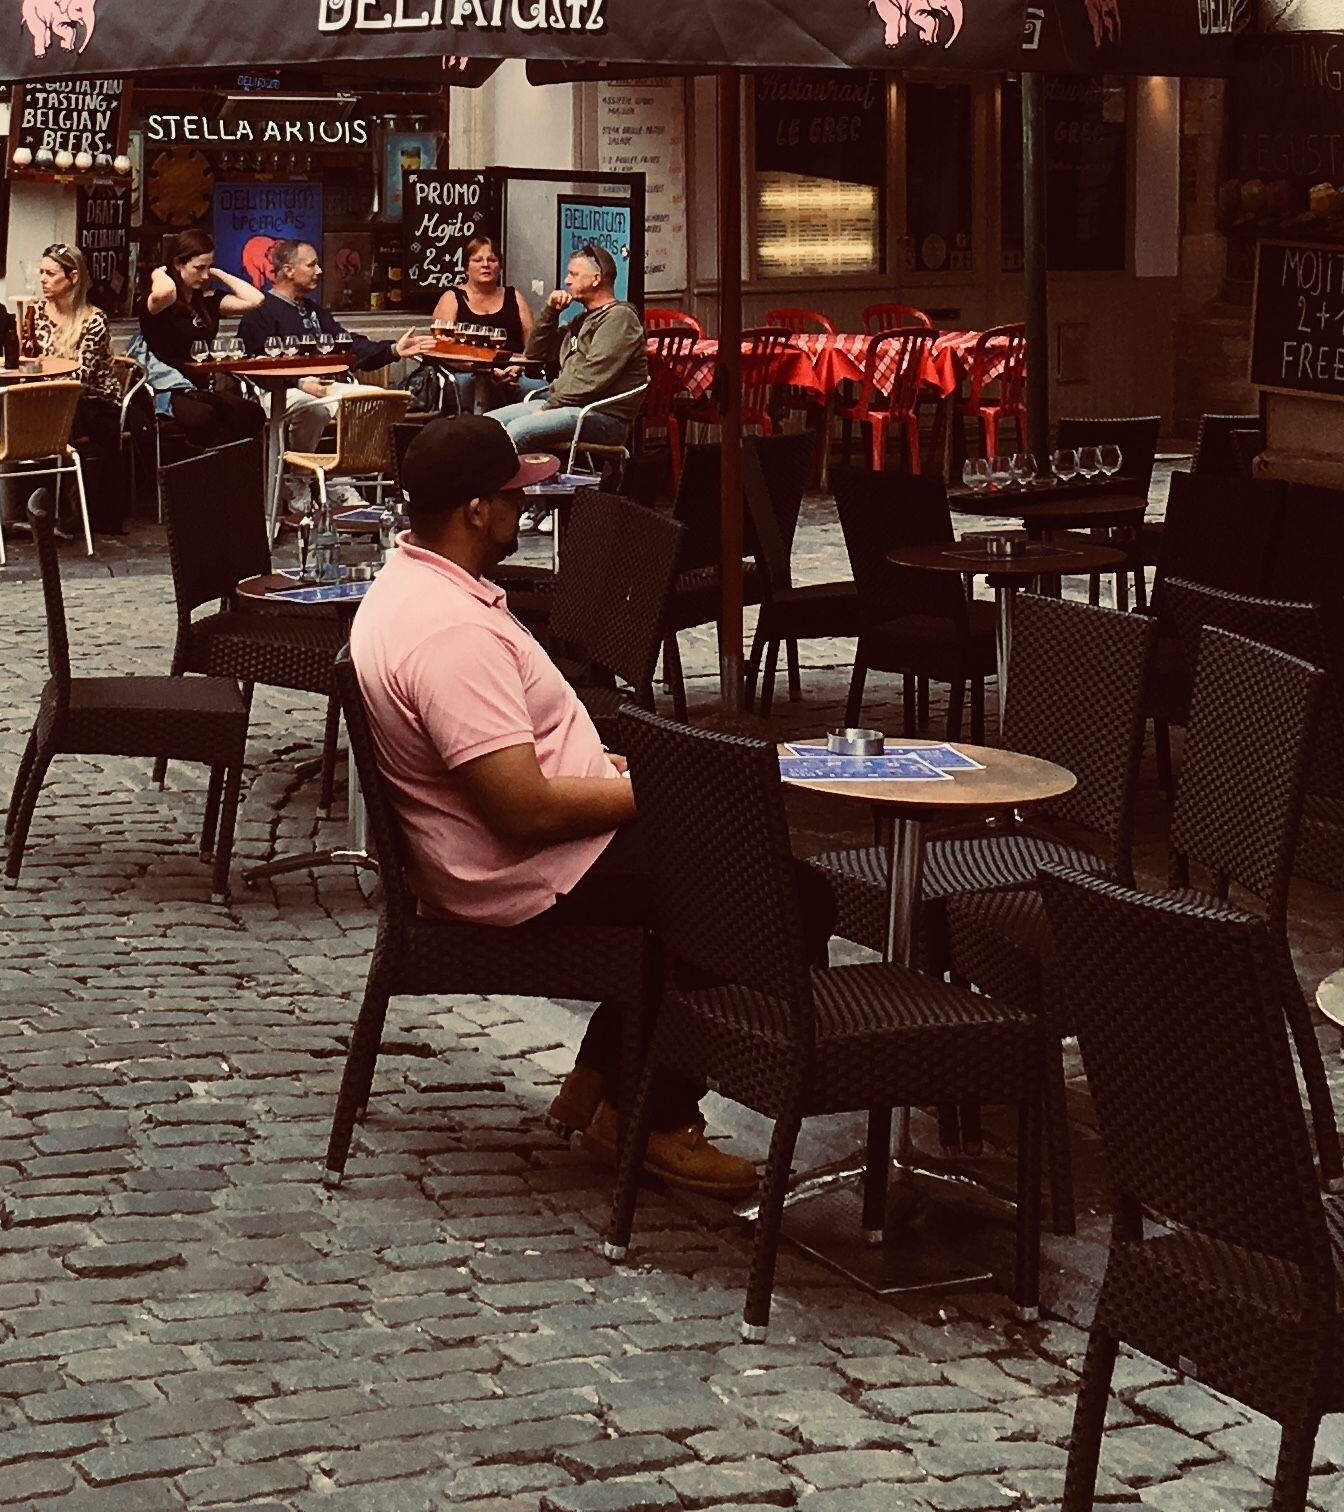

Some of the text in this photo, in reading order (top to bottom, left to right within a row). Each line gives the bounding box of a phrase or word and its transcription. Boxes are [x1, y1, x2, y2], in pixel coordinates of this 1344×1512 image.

[35, 92, 108, 112] TASTING
[22, 108, 111, 132] BELGIAN
[146, 114, 254, 141] STELLA
[39, 129, 106, 156] BEERS
[219, 189, 316, 213] DELIRIUM
[416, 182, 480, 206] PROMO
[87, 199, 125, 226] DRAFT
[564, 206, 627, 231] DELIRIUM
[92, 250, 118, 282] RED
